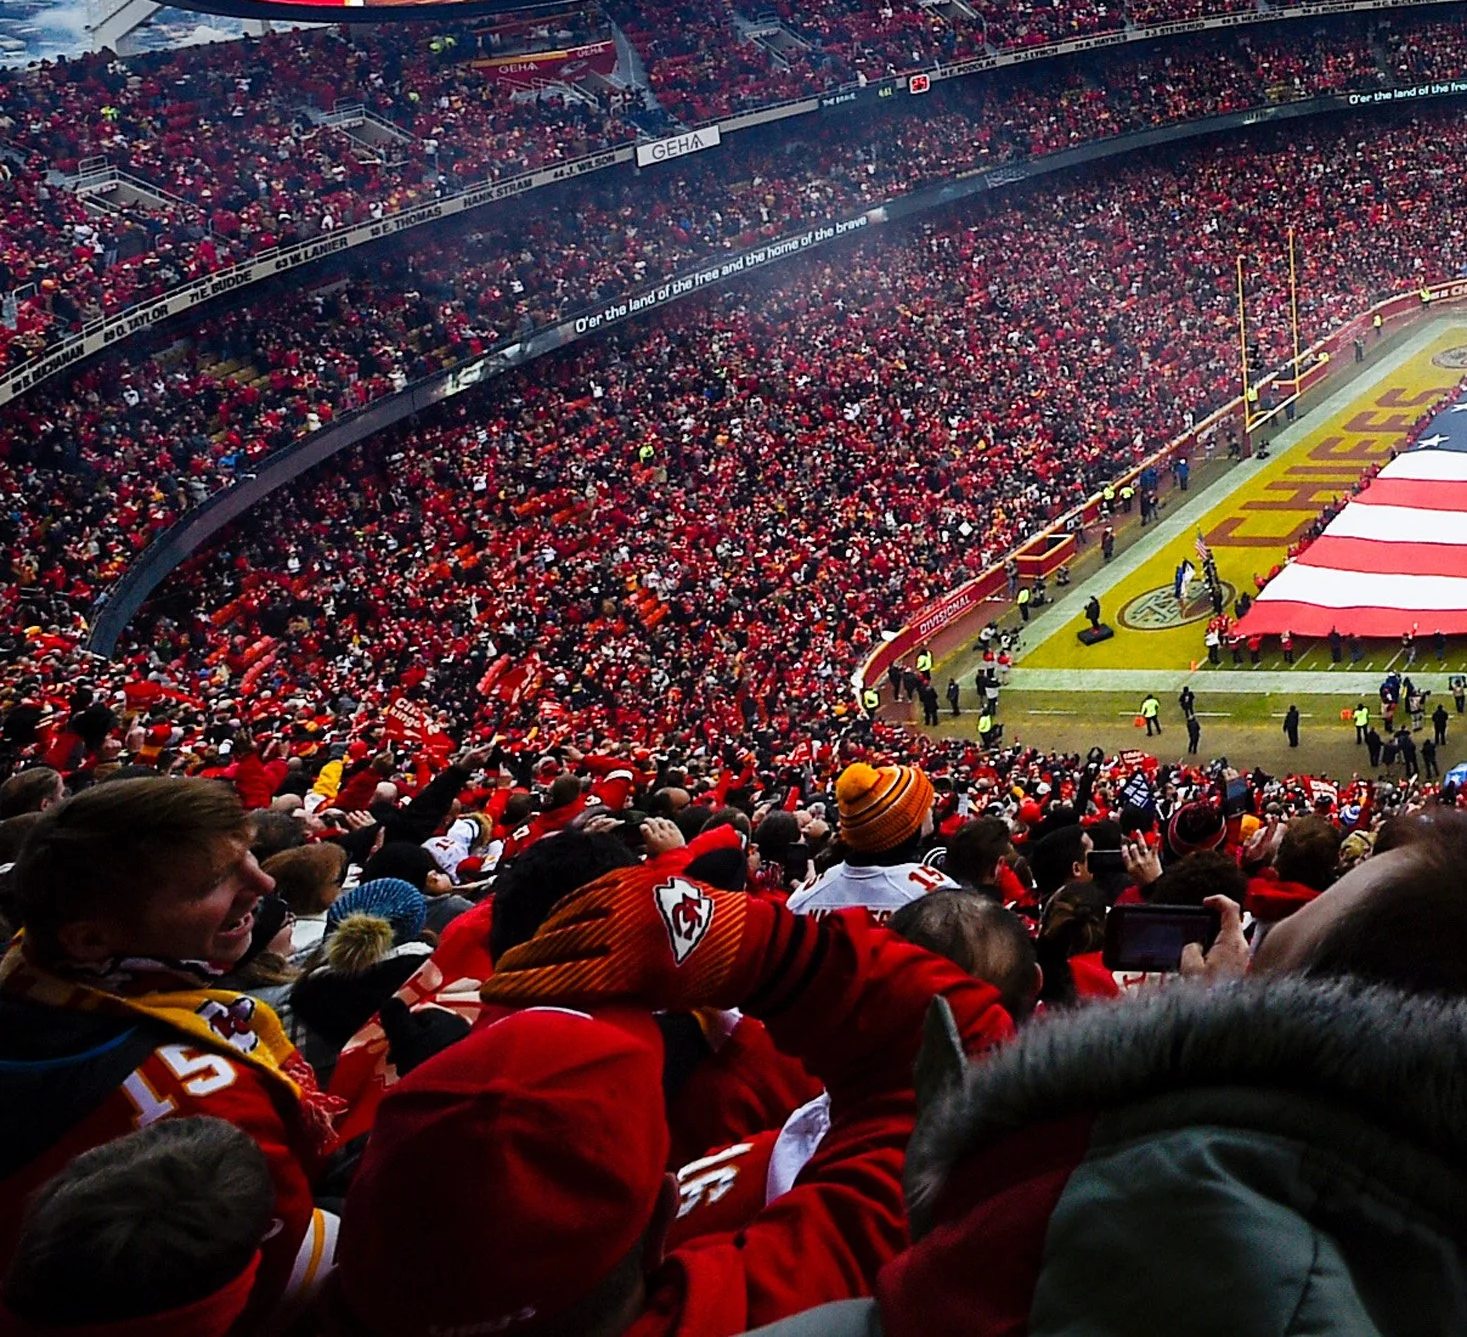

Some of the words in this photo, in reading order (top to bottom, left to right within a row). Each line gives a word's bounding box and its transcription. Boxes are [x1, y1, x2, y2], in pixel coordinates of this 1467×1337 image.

[499, 62, 539, 74] GEHA
[652, 134, 704, 160] GEHA
[463, 189, 494, 208] HANK
[496, 178, 533, 197] STRAM
[304, 236, 348, 261] LANIER
[211, 269, 252, 293] BUDDE
[575, 315, 603, 333] O'er
[605, 304, 627, 320] the
[629, 290, 656, 312] land
[658, 284, 671, 301] of
[672, 276, 692, 296] the
[695, 267, 720, 286] free
[721, 256, 744, 276] and
[745, 249, 765, 267] the
[767, 240, 799, 258] home
[801, 231, 812, 246] of
[815, 227, 834, 241] the
[835, 215, 867, 234] brave
[1203, 386, 1453, 547] CHIEFS
[121, 1045, 239, 1129] 15
